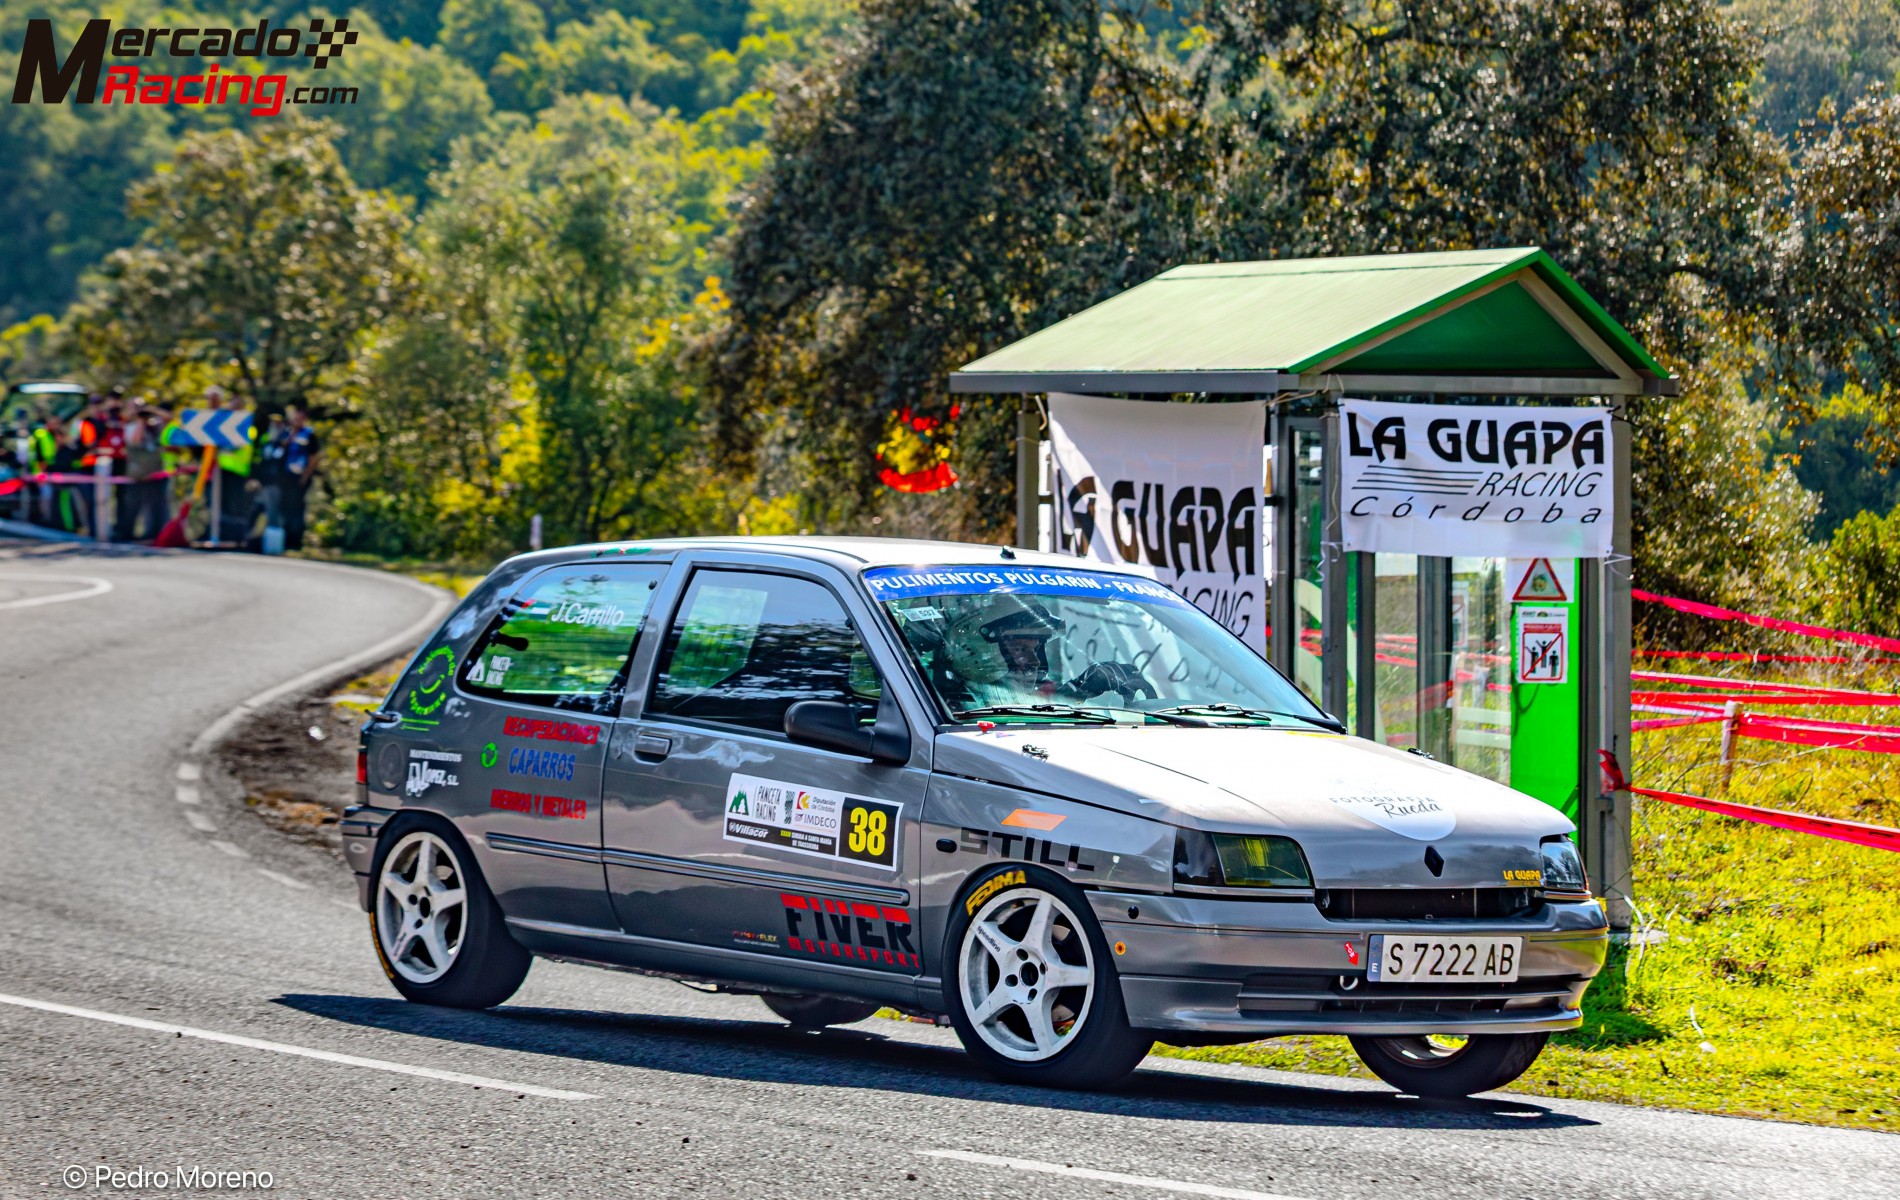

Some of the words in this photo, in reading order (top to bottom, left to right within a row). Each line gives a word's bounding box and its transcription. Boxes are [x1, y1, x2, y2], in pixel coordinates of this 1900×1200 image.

[1346, 412, 1407, 463] LA
[1427, 418, 1605, 470] GUAPA
[1476, 471, 1604, 498] RACING
[1350, 496, 1602, 525] Córdoba
[1056, 467, 1097, 558] LA
[1112, 480, 1257, 584] GUAPA
[870, 572, 1002, 591] PULIMENTOS
[1003, 573, 1103, 590] PULGARIN
[551, 600, 625, 626] J.Carrillo
[508, 747, 577, 781] CAPARROS
[534, 793, 541, 814] Y
[759, 785, 782, 805] PANCETA
[755, 802, 777, 822] RACING
[804, 813, 837, 829] IMDECO
[1373, 800, 1443, 819] Rueda
[848, 806, 888, 857] 38
[960, 827, 1094, 872] STILL
[1503, 870, 1514, 881] LA
[1514, 869, 1541, 881] GUAPA
[965, 870, 1027, 917] FEDIMA
[780, 893, 917, 954] FIVER
[787, 936, 920, 969] MOTORSPORT
[1388, 942, 1405, 976] S
[1412, 943, 1478, 976] 7222
[1483, 943, 1515, 976] AB
[1371, 962, 1378, 972] E
